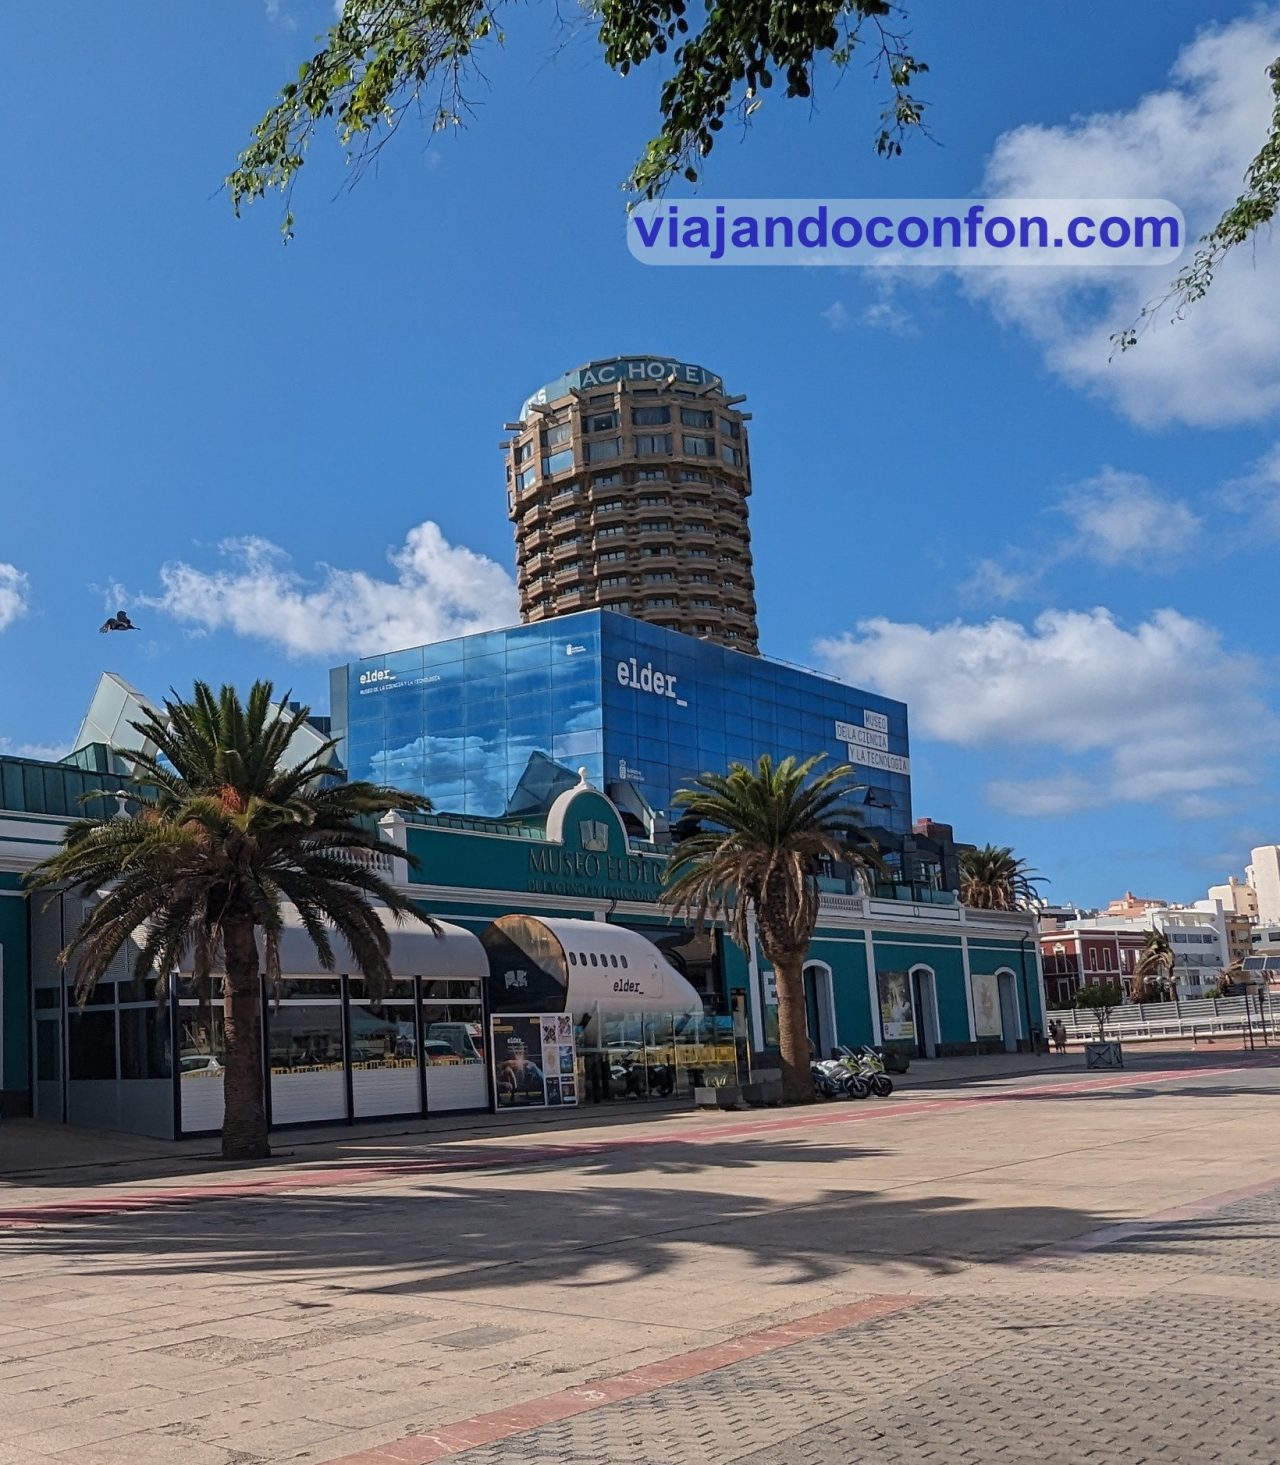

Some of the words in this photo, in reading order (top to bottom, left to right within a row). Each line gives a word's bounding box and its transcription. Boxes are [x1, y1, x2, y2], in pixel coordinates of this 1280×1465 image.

[581, 366, 615, 387] AC
[865, 713, 886, 730] MUSEO
[837, 724, 846, 738] DE
[847, 727, 856, 740] LA
[858, 731, 887, 748] CIENCIA
[849, 746, 855, 760] Y
[857, 750, 865, 762] LA
[529, 847, 600, 878] MUSEO
[607, 855, 663, 885] ELDER
